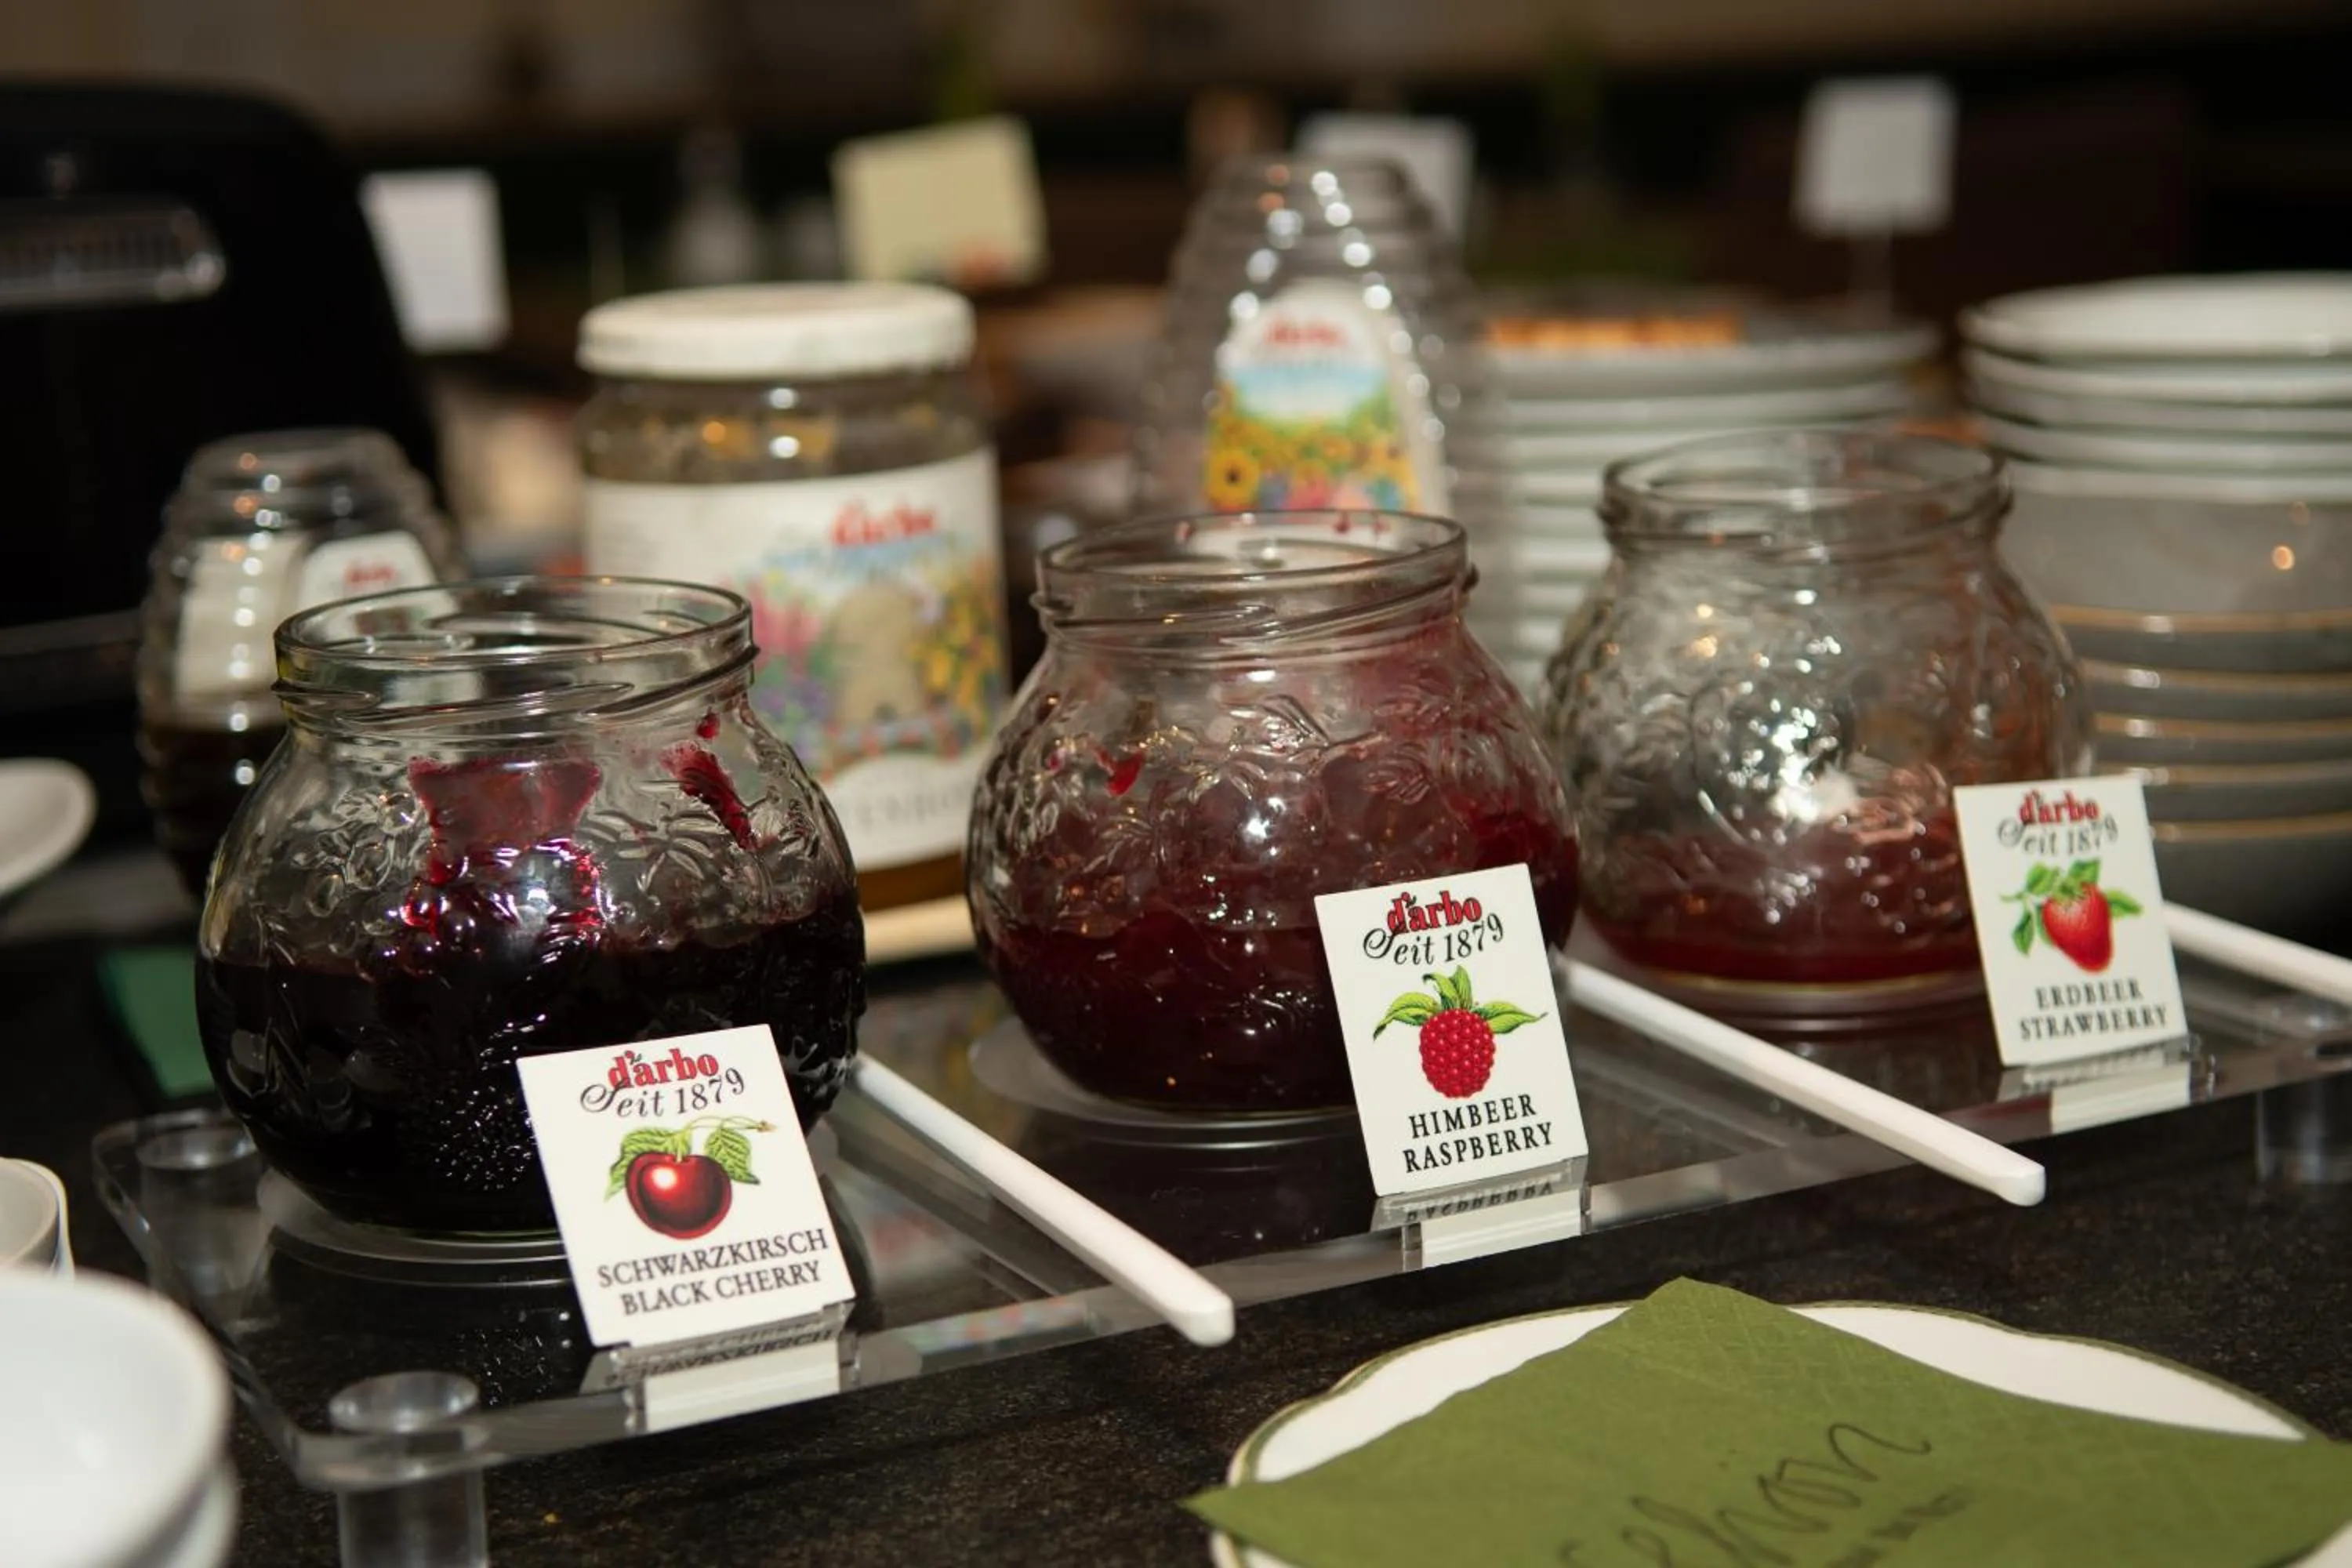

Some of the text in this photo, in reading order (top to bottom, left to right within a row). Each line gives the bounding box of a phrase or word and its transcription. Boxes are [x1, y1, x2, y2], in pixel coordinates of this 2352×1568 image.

[1363, 913, 1504, 965] Seit 1879
[2036, 977, 2144, 1009] ERDBEER
[2020, 1006, 2168, 1041] STRAWBERRY
[579, 1066, 746, 1117] Seit 1879
[1409, 1094, 1537, 1139] HIMBEER
[1403, 1121, 1554, 1174] RASPBERRY
[597, 1228, 829, 1289] SCHWARZKIRSCH
[619, 1260, 822, 1317] BLACK CHERRY
